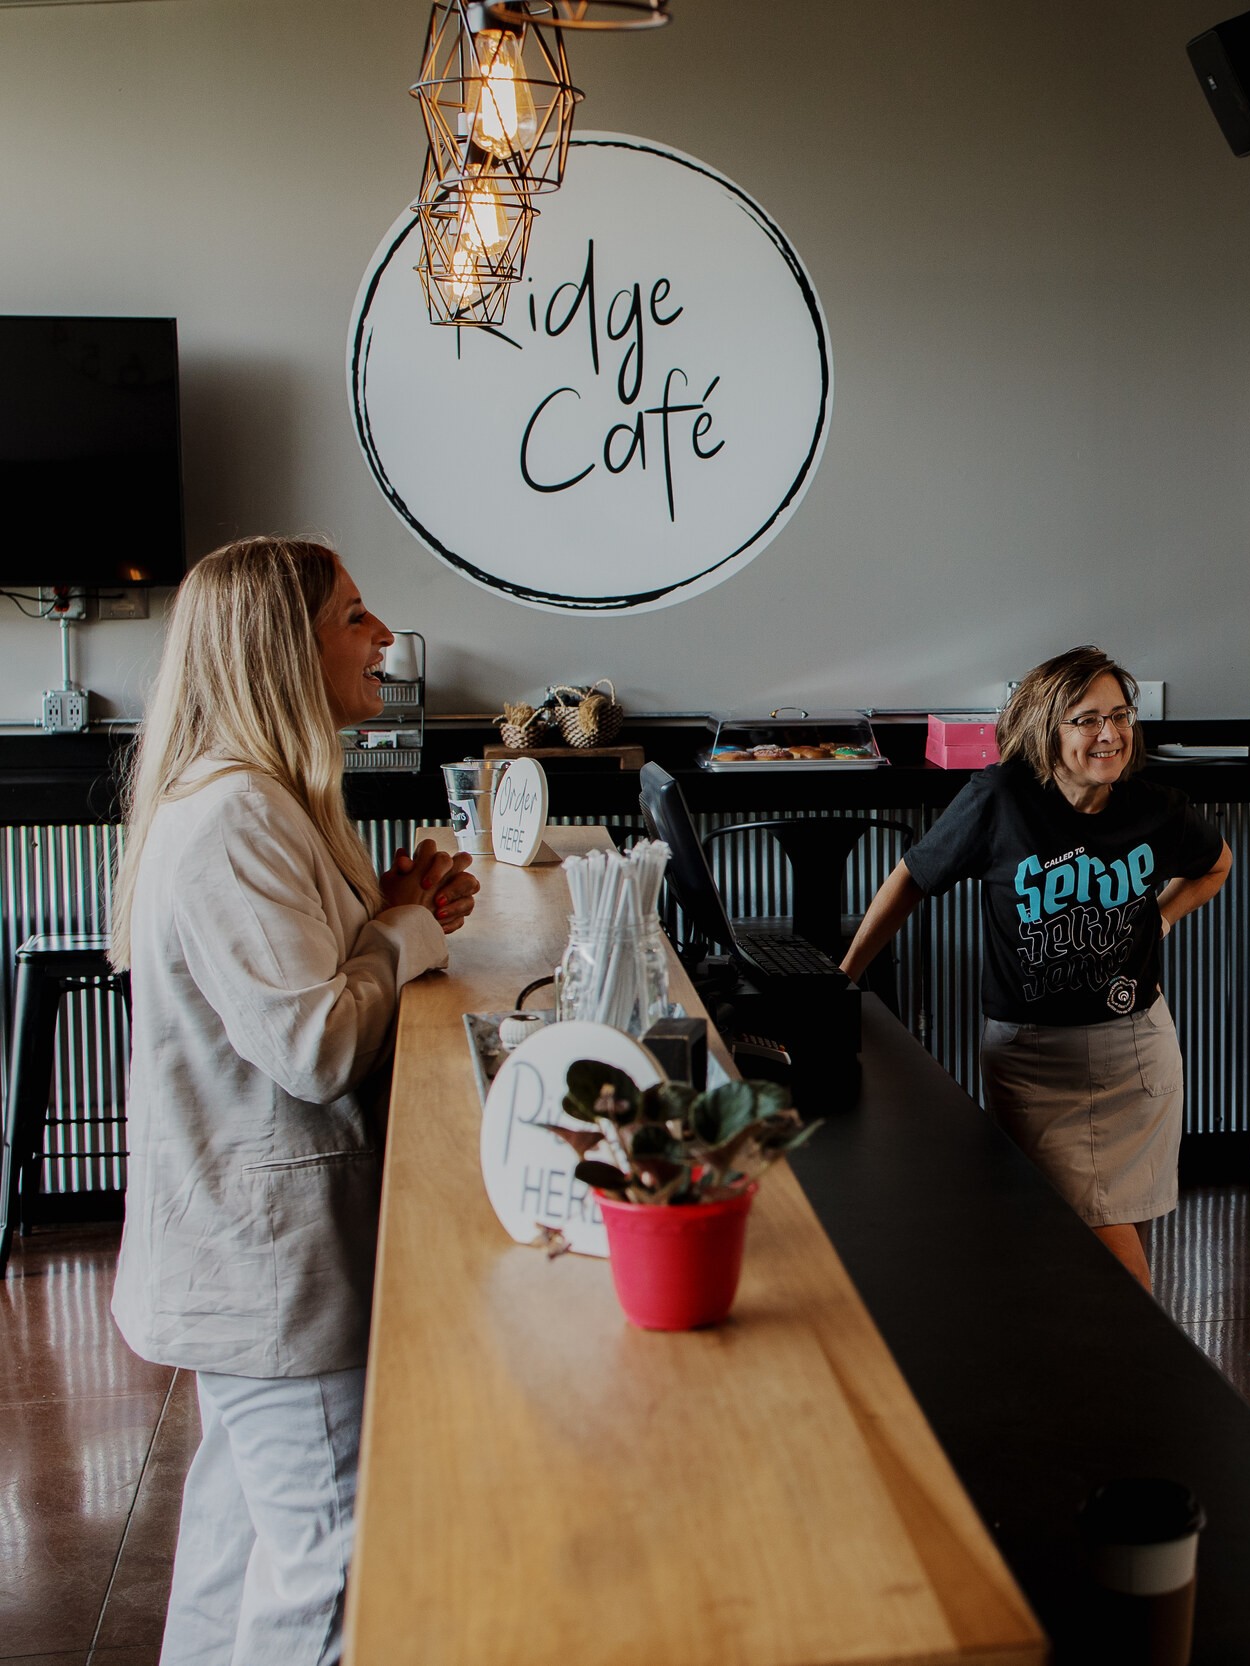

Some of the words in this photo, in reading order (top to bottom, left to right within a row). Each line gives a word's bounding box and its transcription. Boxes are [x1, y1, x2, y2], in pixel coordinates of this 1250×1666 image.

[520, 367, 726, 523] Café
[500, 776, 538, 827] Order
[500, 826, 525, 853] HERE
[1044, 851, 1074, 869] CALLED
[1075, 846, 1085, 855] TO
